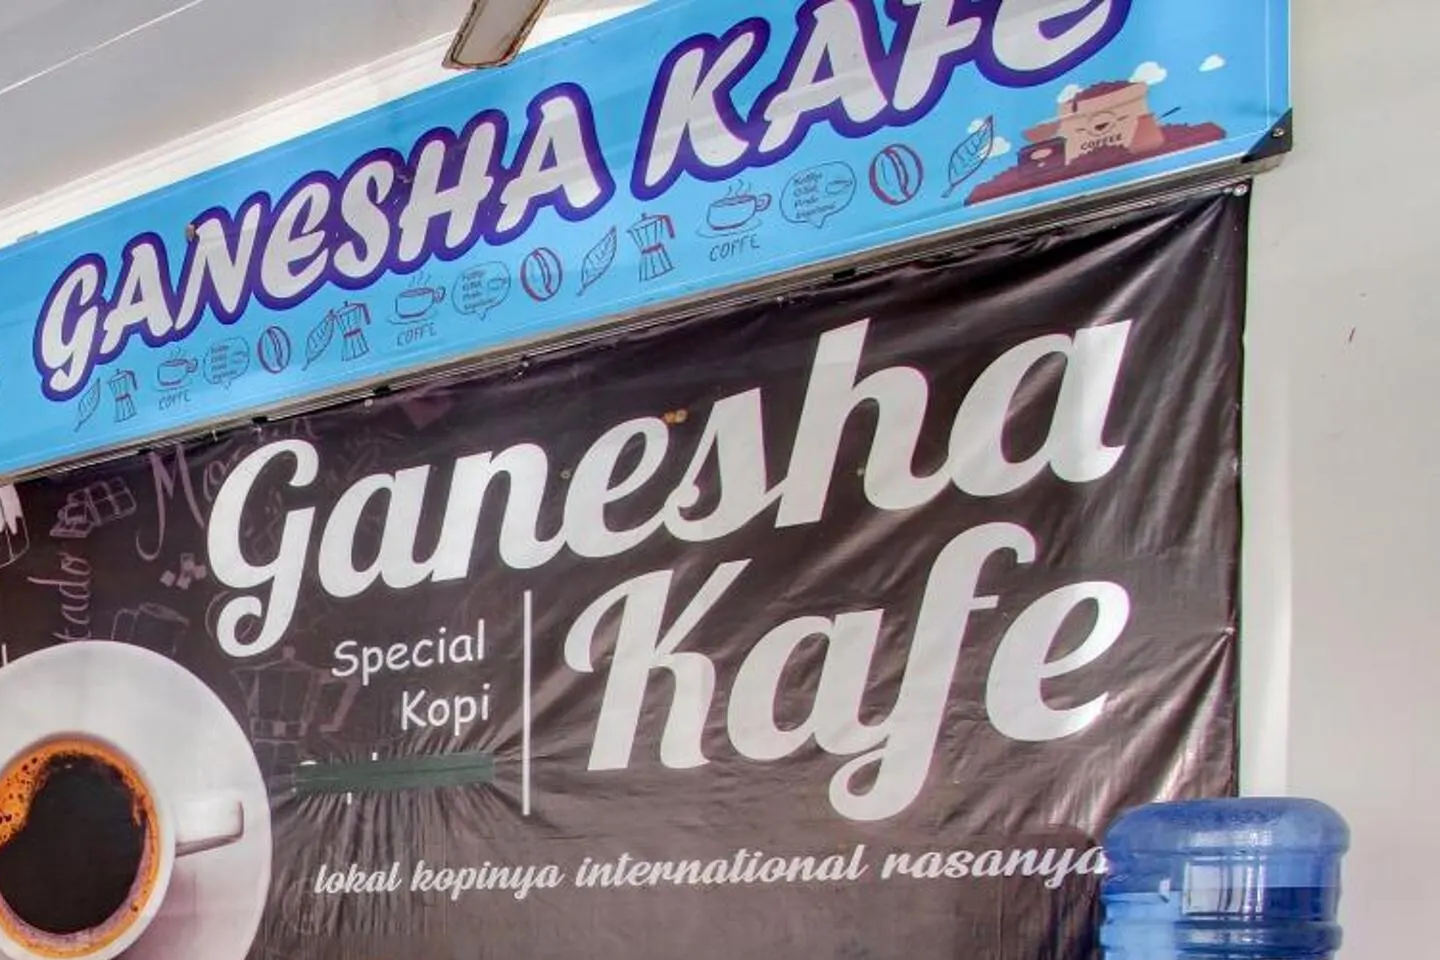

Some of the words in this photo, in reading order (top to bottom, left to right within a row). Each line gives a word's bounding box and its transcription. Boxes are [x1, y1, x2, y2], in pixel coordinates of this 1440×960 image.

[1080, 132, 1124, 152] COFFEE
[35, 87, 611, 397] GANESHA
[708, 233, 761, 263] COFFE
[205, 318, 1134, 658] Ganesha
[26, 551, 94, 642] tado
[330, 617, 486, 687] Special
[563, 520, 1133, 822] Kafe
[400, 682, 491, 737] Kopi
[313, 858, 403, 895] lokal
[409, 858, 565, 901] kopinya
[574, 843, 869, 888] international
[880, 844, 1110, 890] rasanya
